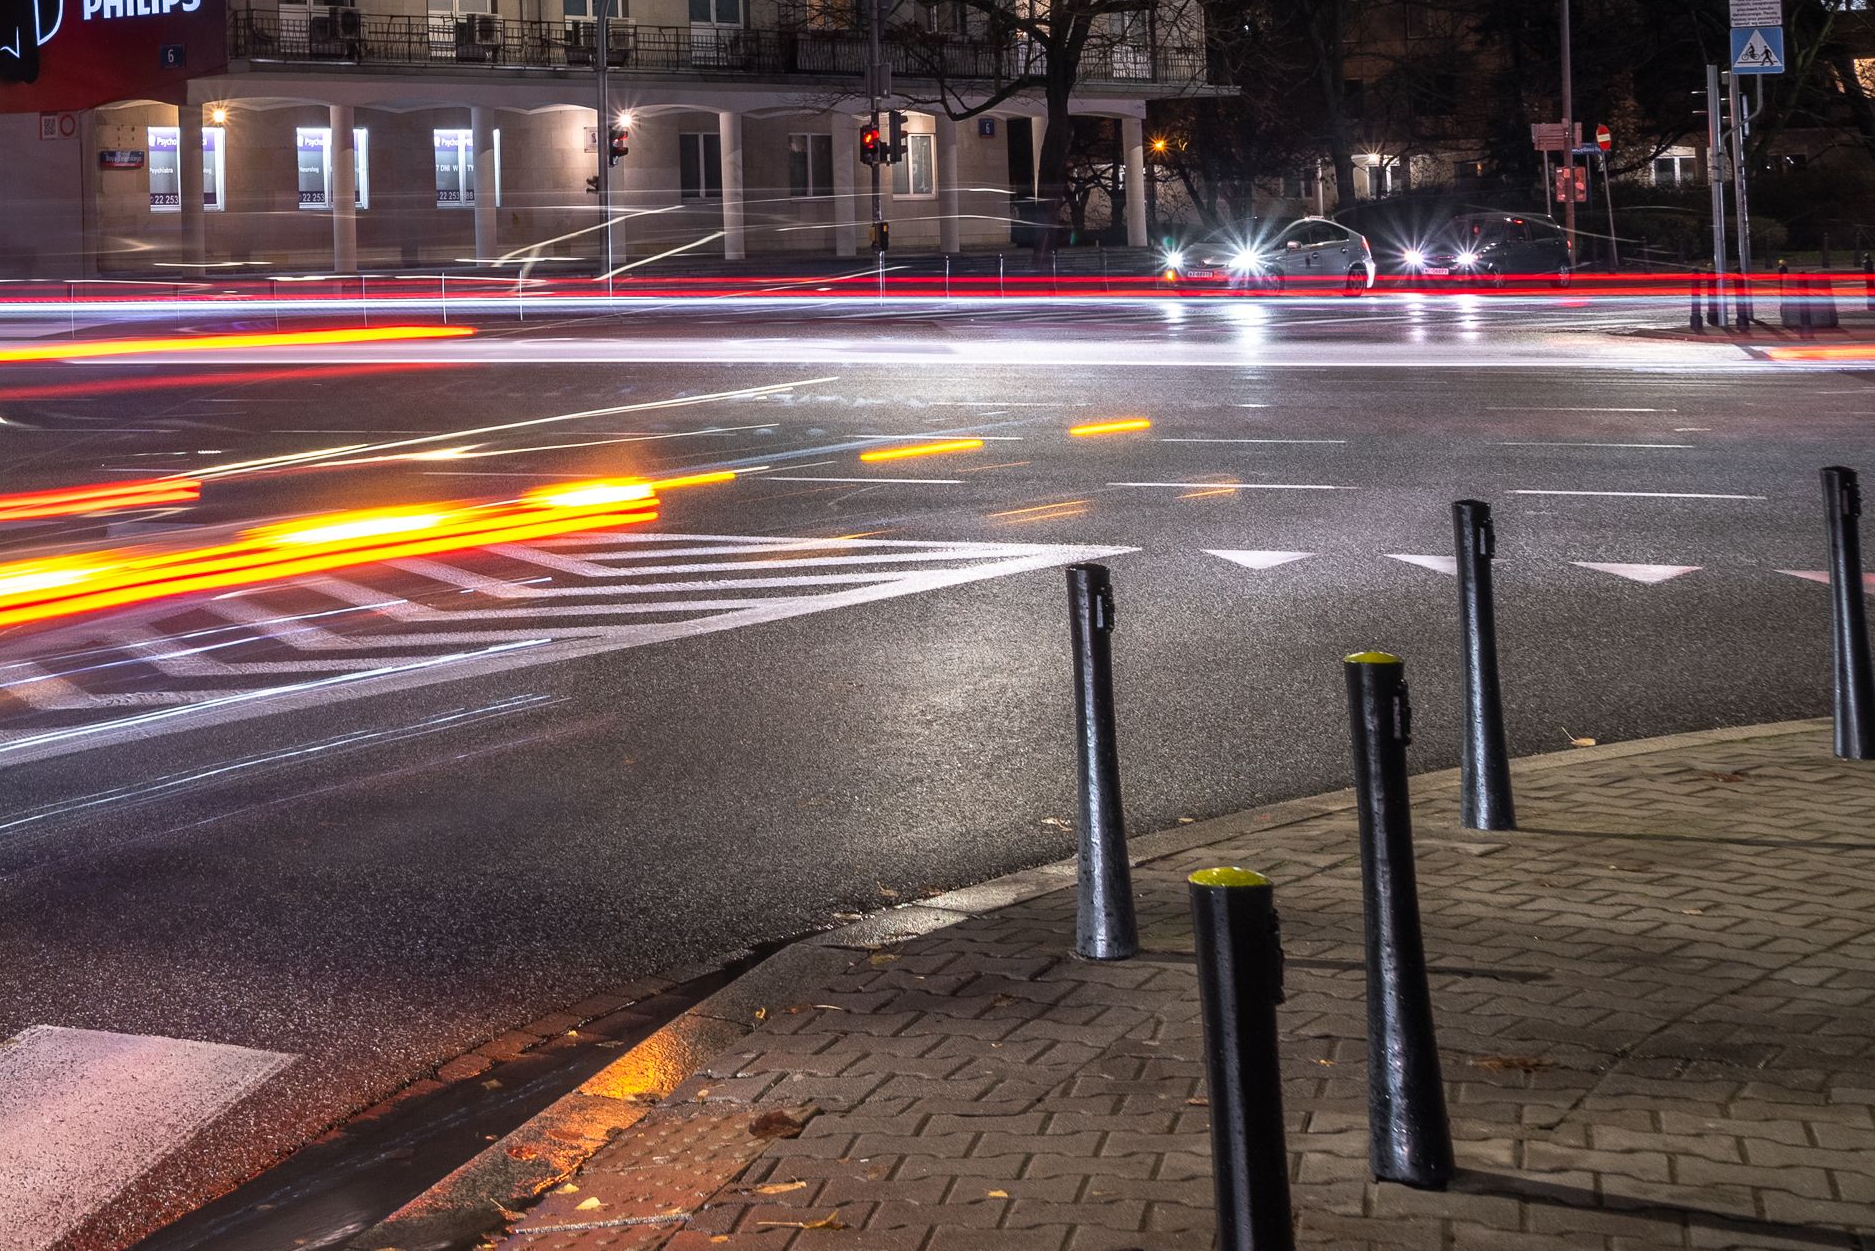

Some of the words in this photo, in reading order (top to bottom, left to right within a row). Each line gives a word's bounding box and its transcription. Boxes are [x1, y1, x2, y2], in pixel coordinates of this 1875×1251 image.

[167, 48, 175, 64] 6
[155, 196, 163, 204] 22
[166, 195, 179, 204] 253
[303, 193, 311, 202] 22
[313, 193, 325, 202] 253
[439, 192, 447, 200] 22
[449, 192, 459, 200] 253
